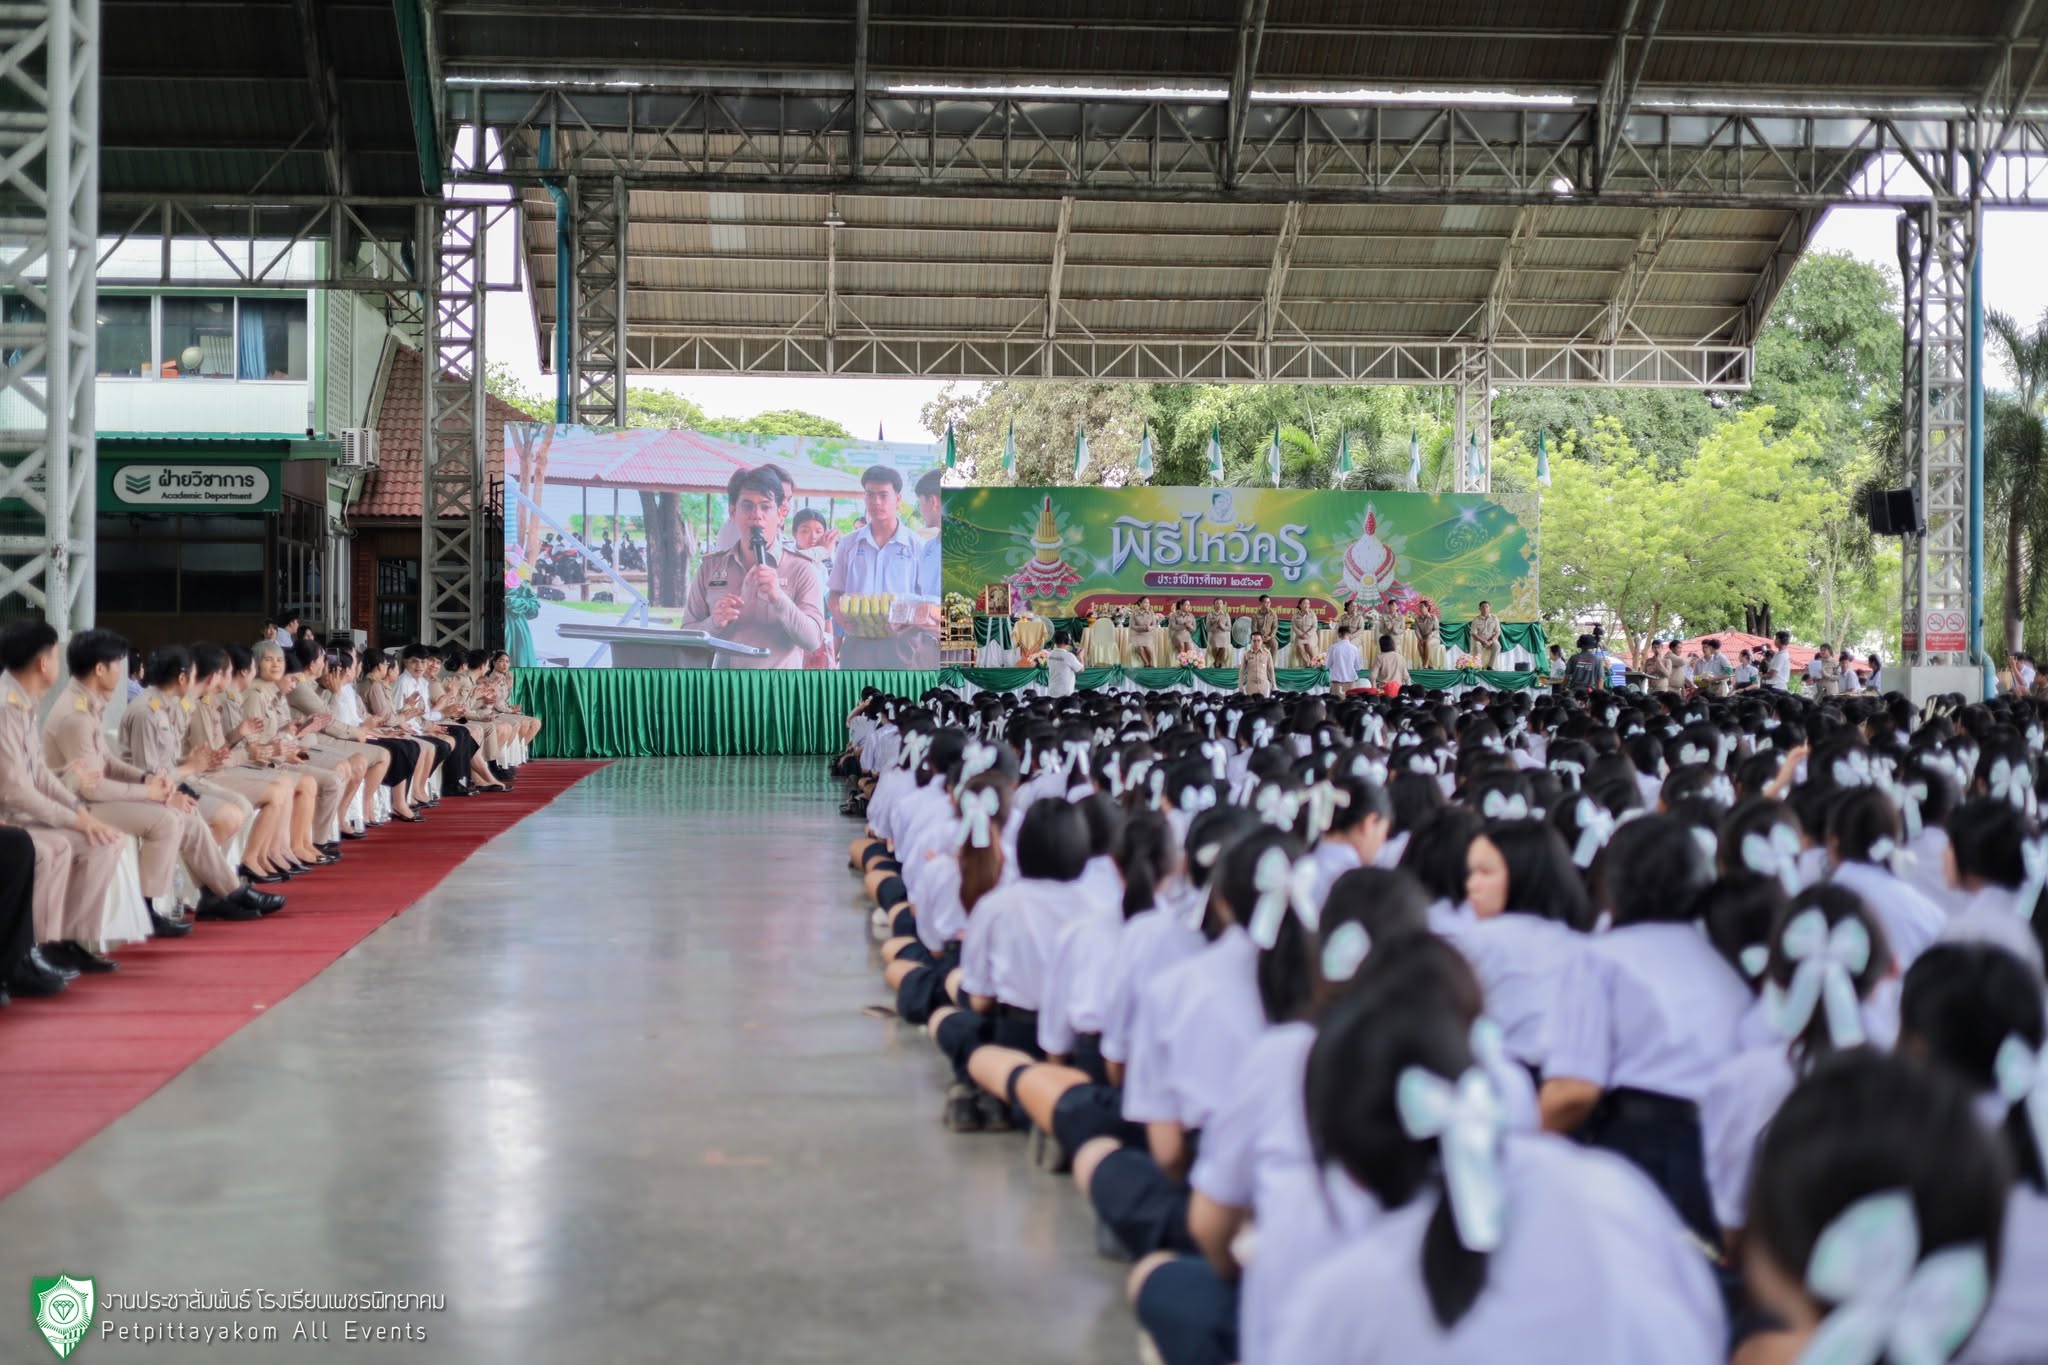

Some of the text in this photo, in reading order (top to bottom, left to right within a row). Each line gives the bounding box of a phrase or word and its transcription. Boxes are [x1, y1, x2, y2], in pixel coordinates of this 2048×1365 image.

[158, 468, 255, 488] ฝ่ายวิชาการ
[161, 491, 253, 502] Academic Department
[1110, 511, 1308, 581] พิธีไหว้ครู
[1157, 572, 1227, 586] ประจำปีการศึกษา
